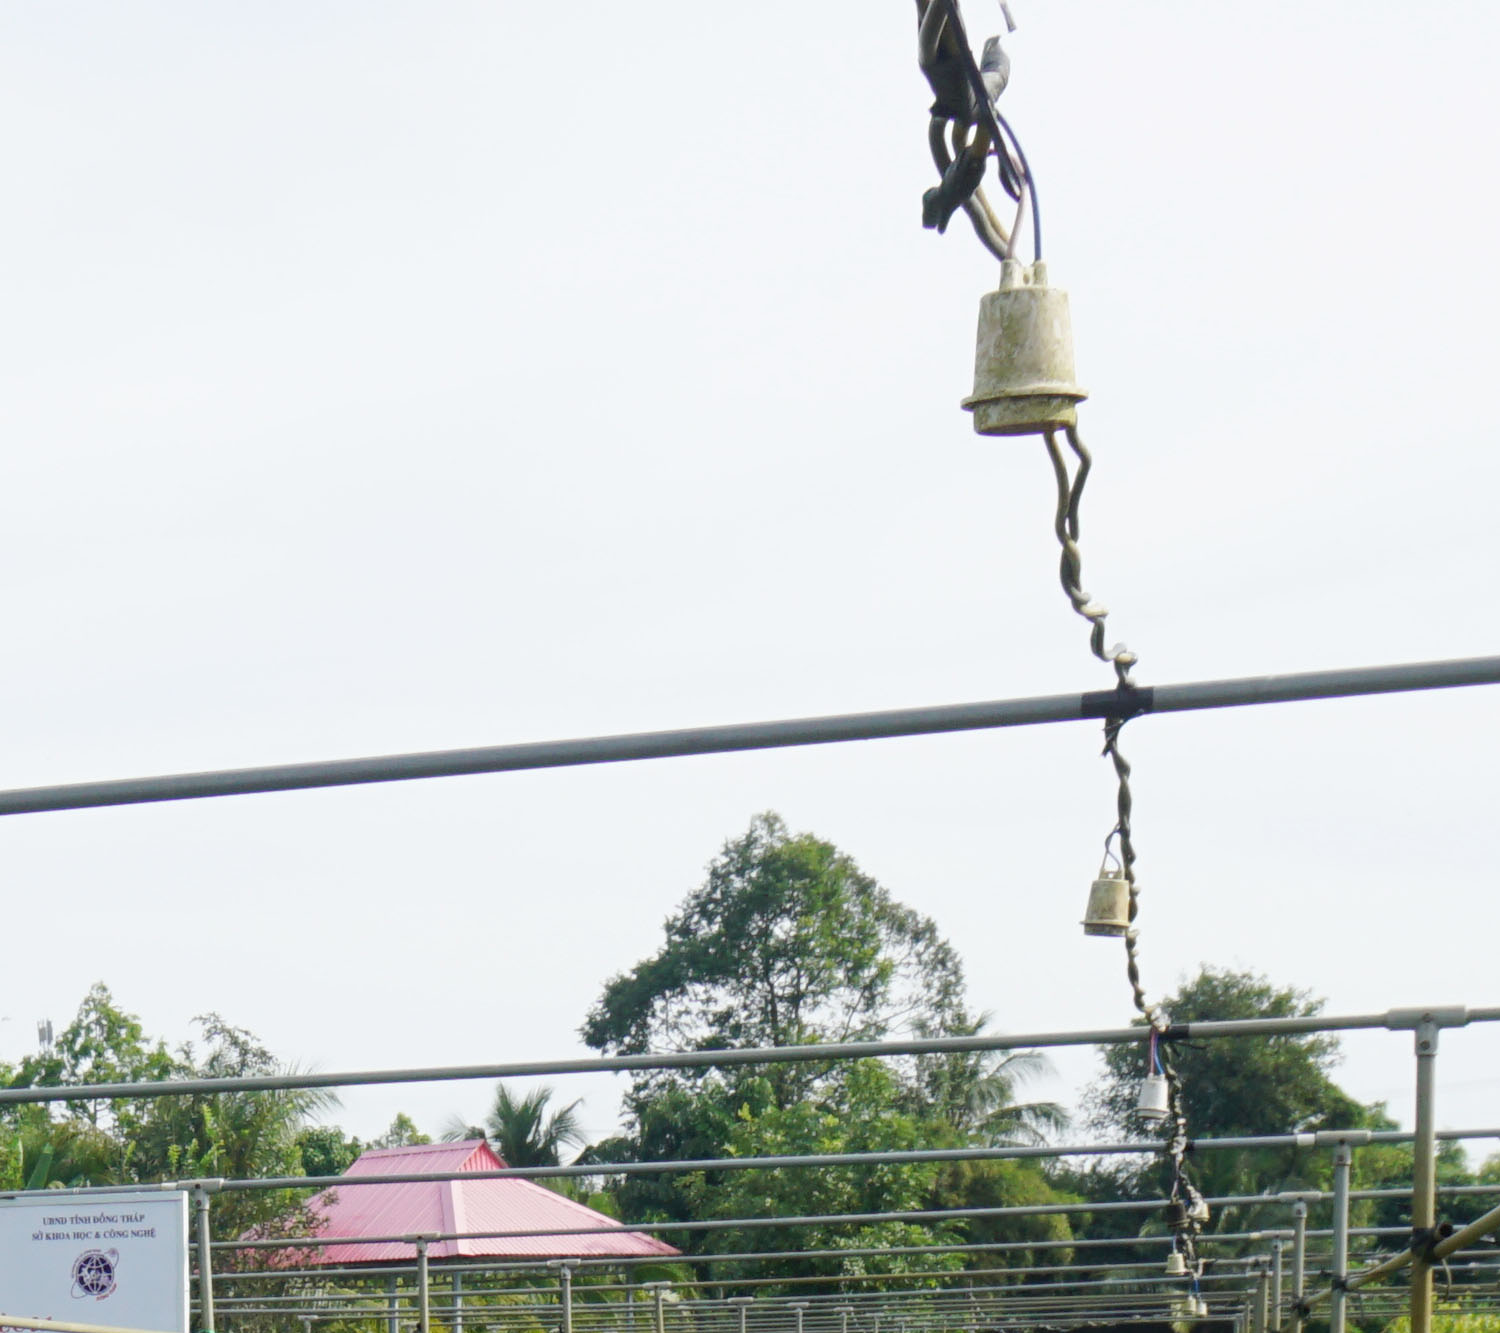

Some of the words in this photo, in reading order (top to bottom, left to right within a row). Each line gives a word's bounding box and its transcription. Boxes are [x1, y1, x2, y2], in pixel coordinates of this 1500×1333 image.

[43, 1217, 67, 1225] UBND
[93, 1212, 118, 1224] ĐỒNG
[120, 1213, 145, 1223] THÁP
[45, 1232, 71, 1241] KHOA
[73, 1231, 92, 1241] HỌC
[94, 1231, 101, 1239] &
[103, 1228, 128, 1239] CÔNG
